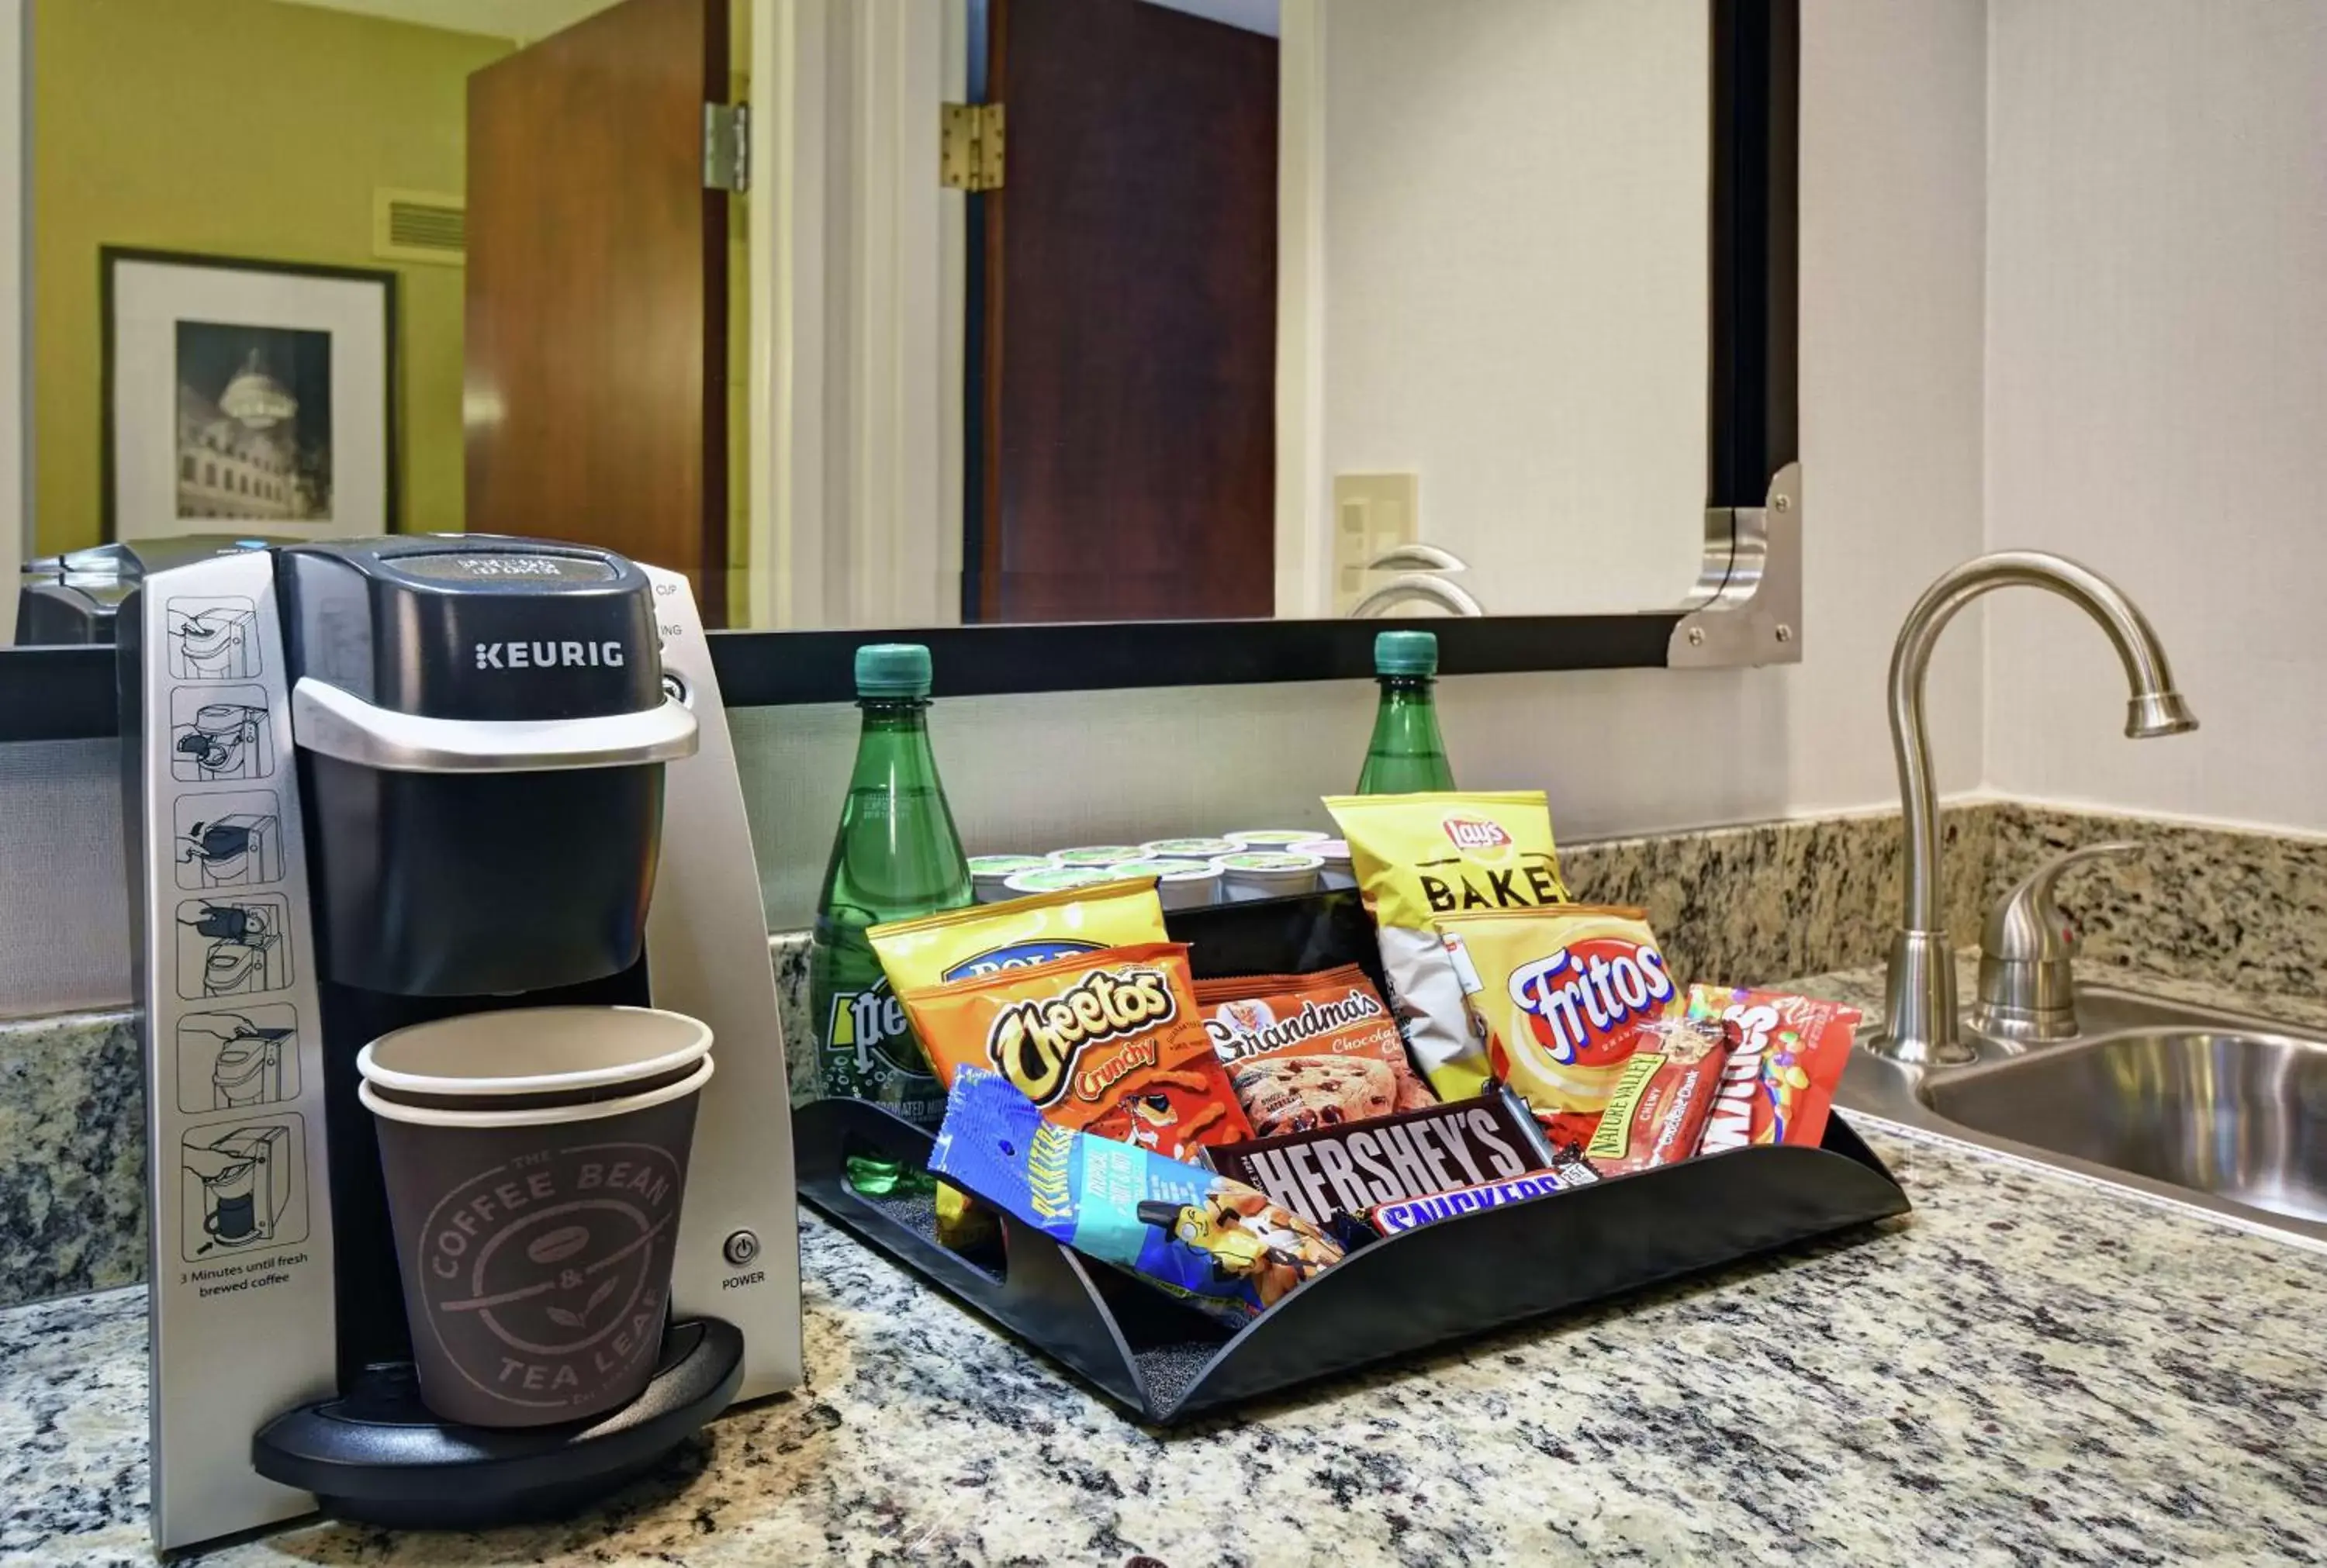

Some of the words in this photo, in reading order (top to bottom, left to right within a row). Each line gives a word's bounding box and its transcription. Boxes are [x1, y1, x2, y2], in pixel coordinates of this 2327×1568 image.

[655, 583, 677, 596] CUP
[475, 641, 624, 669] KEURIG
[1449, 820, 1505, 851] Lay's
[1509, 946, 1675, 1065] Fritos
[991, 971, 1174, 1107] Cheetos
[1203, 990, 1383, 1064] Grandma's
[1333, 1025, 1395, 1051] Chocolat
[1075, 1037, 1157, 1100] Crunchy
[1589, 1097, 1628, 1152] NATURE
[1615, 1055, 1658, 1099] VALLEY
[1638, 1085, 1661, 1121] CHEWY
[510, 1150, 553, 1169] THE
[1251, 1108, 1526, 1224] HERSHEY'S
[432, 1172, 556, 1278] COFFEE
[577, 1162, 670, 1207] BEAN
[191, 1266, 244, 1283] Minutes
[246, 1258, 275, 1273] until
[278, 1252, 308, 1266] fresh
[559, 1268, 583, 1289] &
[721, 1271, 766, 1291] POWER
[199, 1280, 247, 1298] brewed
[251, 1273, 290, 1289] coffee
[498, 1356, 579, 1390] TEA
[594, 1287, 659, 1373] LEAF
